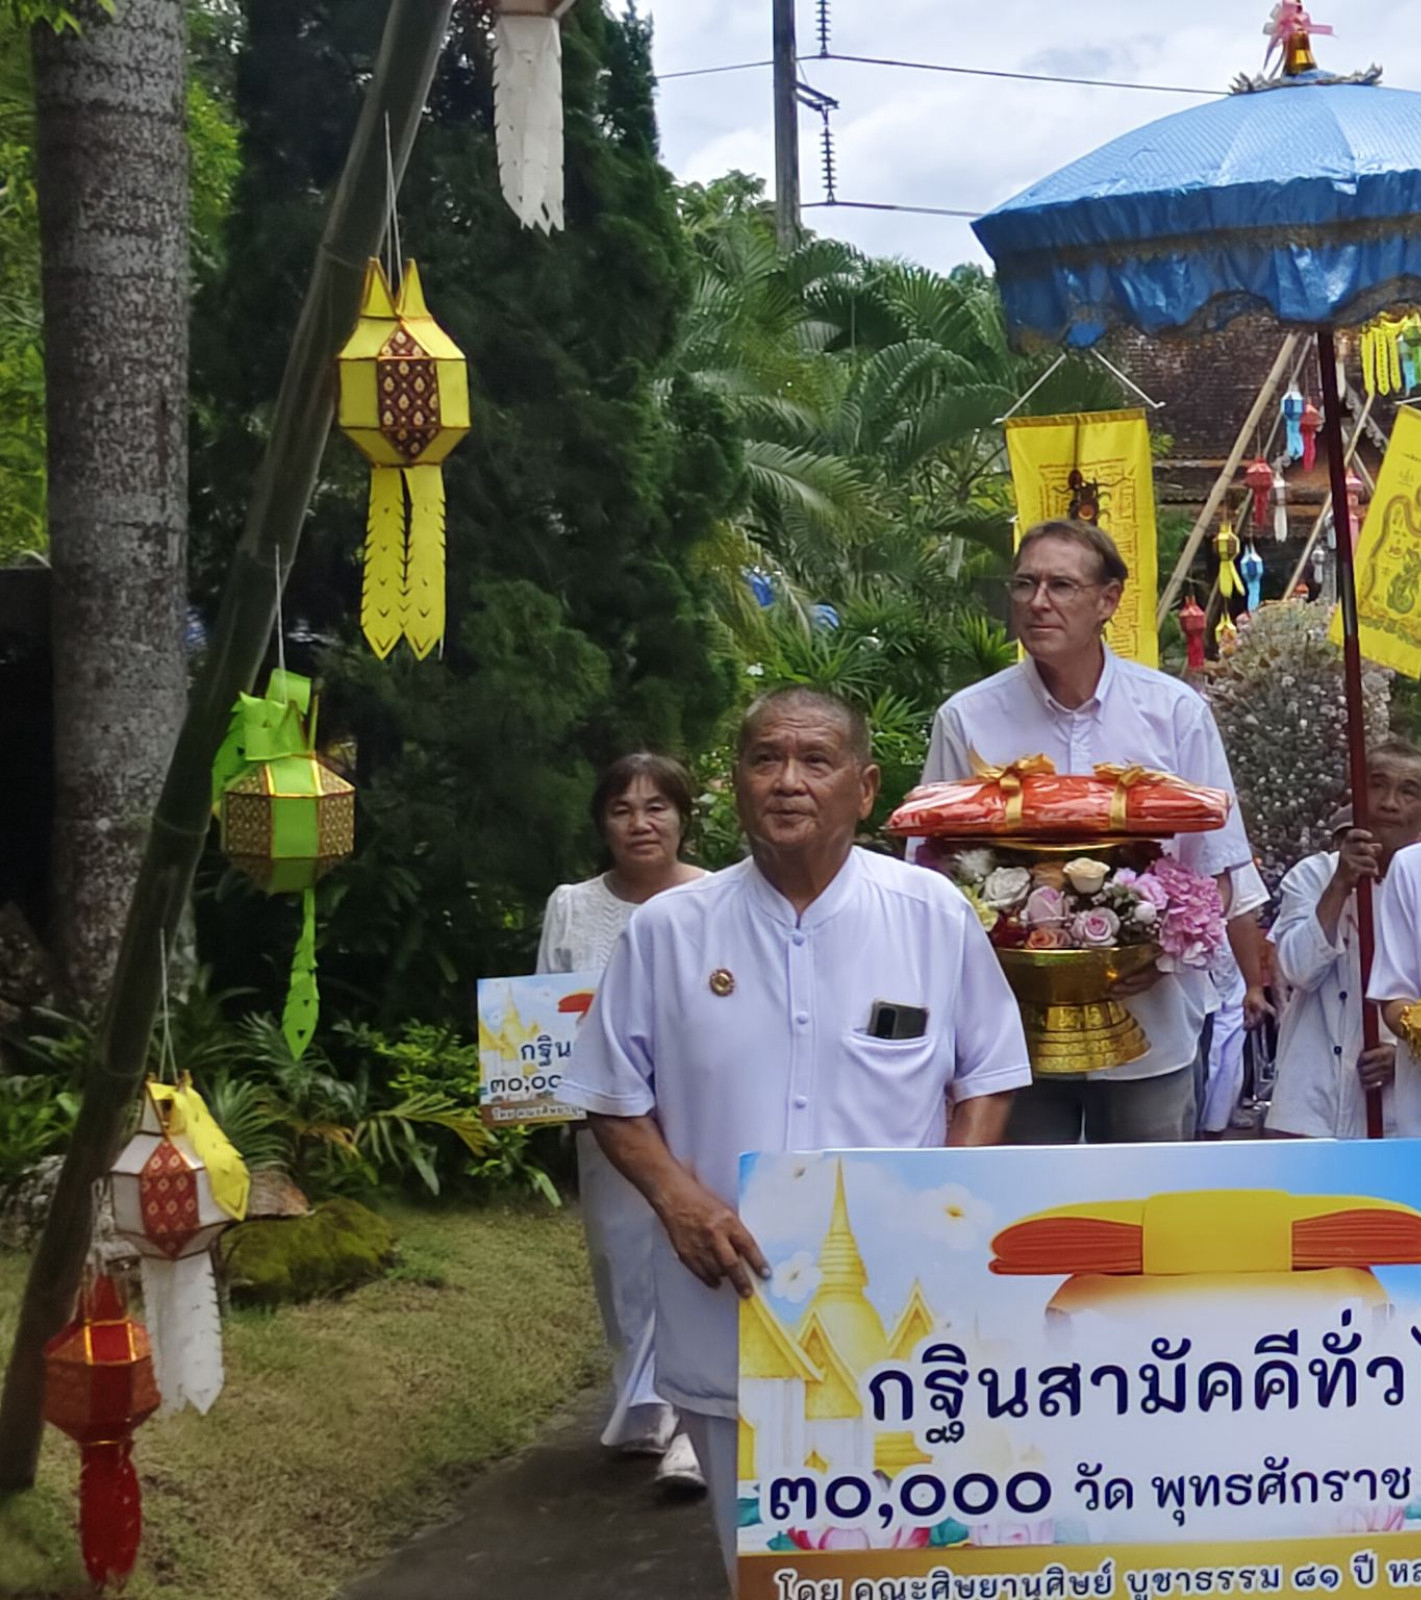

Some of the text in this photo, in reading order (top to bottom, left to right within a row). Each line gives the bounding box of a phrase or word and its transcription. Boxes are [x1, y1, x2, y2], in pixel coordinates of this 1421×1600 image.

[769, 1471, 1052, 1529] ๓๐,๐๐๐
[1074, 1462, 1134, 1511] วัด
[1151, 1456, 1412, 1527] พุทธศักราช
[778, 1572, 840, 1600] โดย
[855, 1561, 1113, 1600] คณะศิษยานุศิษย์
[1127, 1563, 1280, 1600] บูชาธรรม
[1294, 1567, 1340, 1588] ๘๑
[1353, 1552, 1376, 1585] ปี
